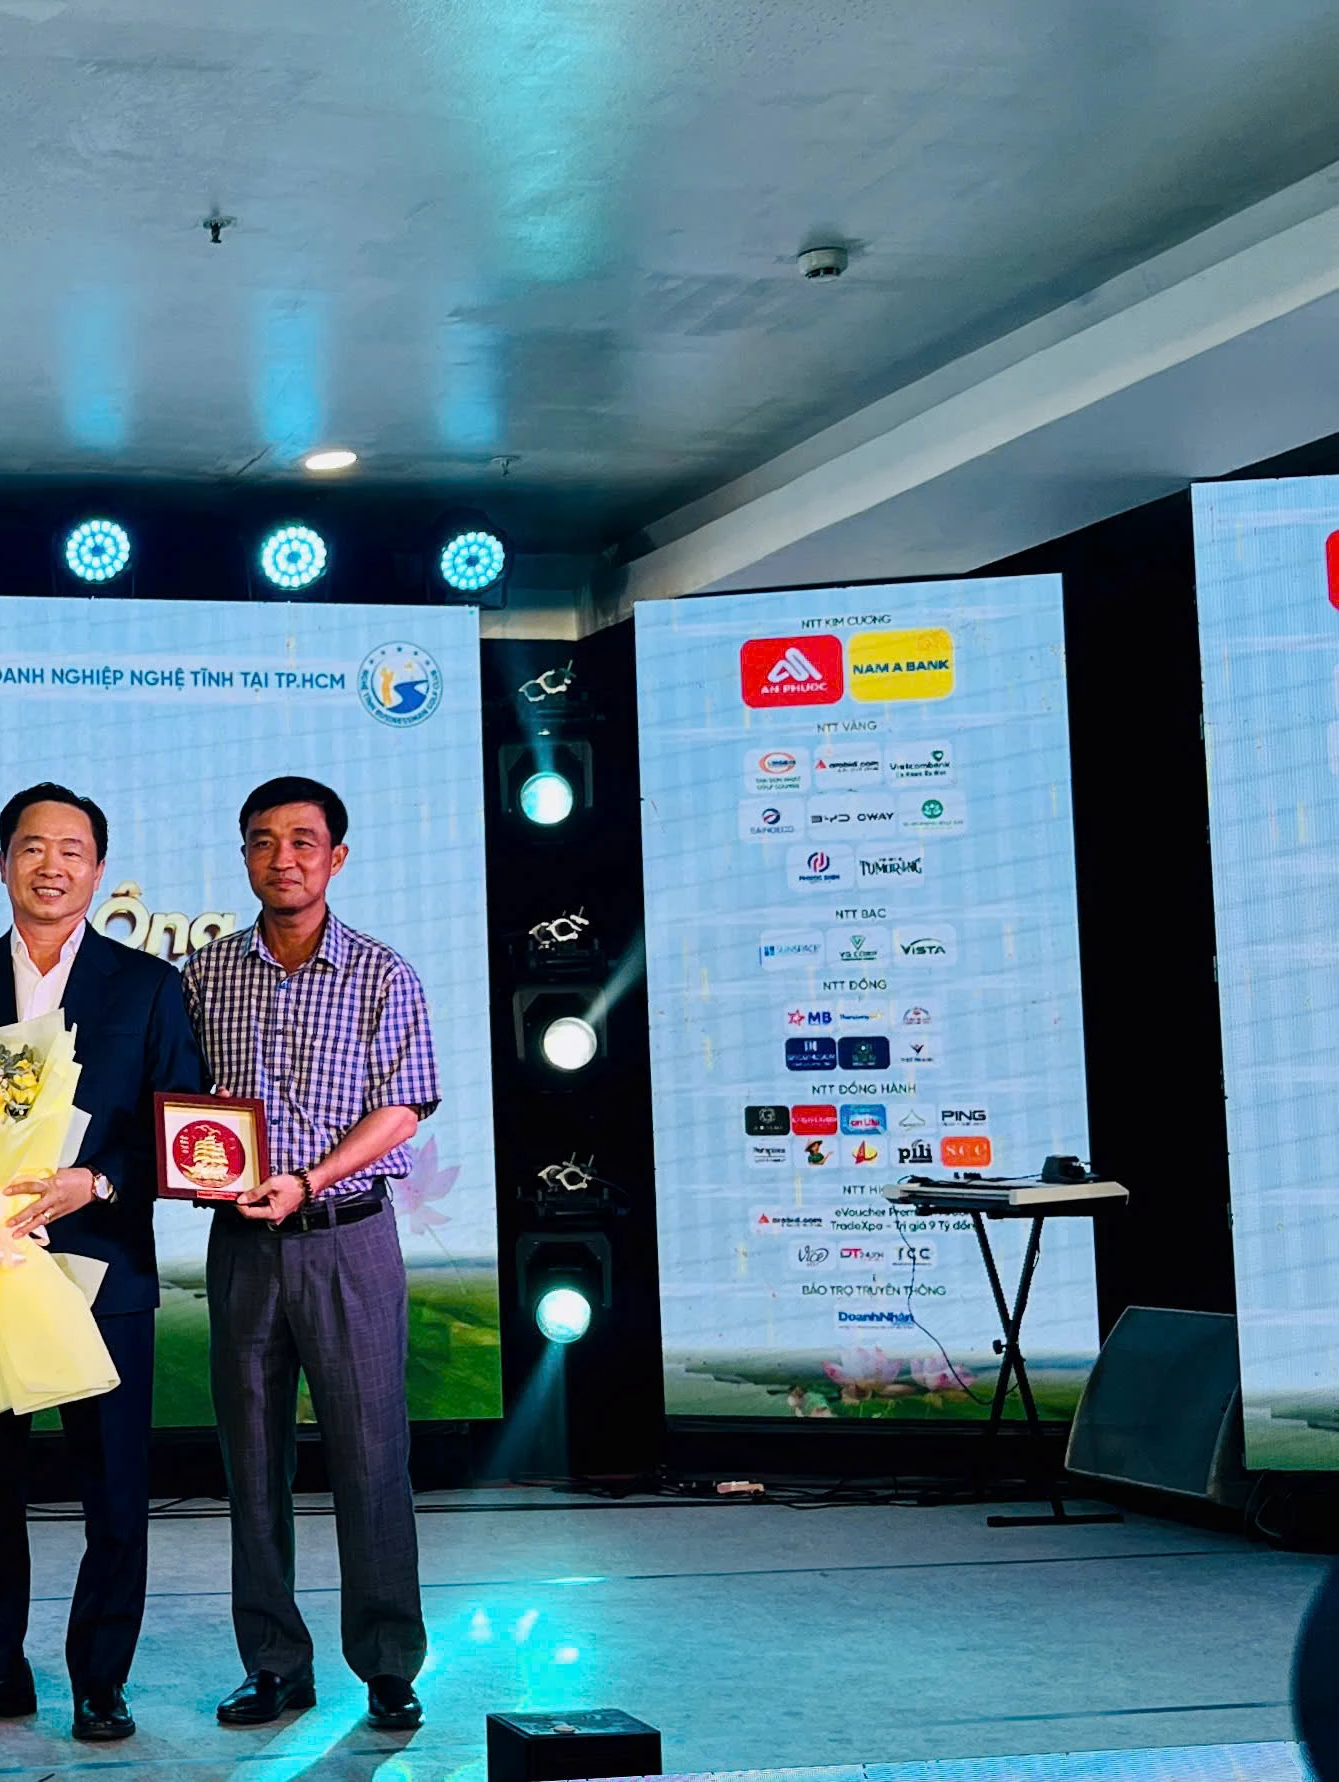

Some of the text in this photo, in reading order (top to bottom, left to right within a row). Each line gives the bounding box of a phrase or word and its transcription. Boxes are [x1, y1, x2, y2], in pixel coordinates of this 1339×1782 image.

[802, 619, 822, 628] NTT
[853, 659, 949, 674] NAM A BANK
[51, 666, 124, 690] NGHIỆP
[130, 668, 185, 691] NGHỆ
[190, 667, 233, 687] TĨNH
[240, 672, 269, 693] TẠI
[275, 672, 346, 689] TP.HCM
[817, 724, 838, 733] NTT
[835, 909, 858, 919] NTT
[823, 981, 845, 990] NTT
[808, 1011, 832, 1025] MB
[812, 1085, 834, 1094] NTT
[941, 1110, 987, 1121] PING
[843, 1186, 865, 1194] NTT
